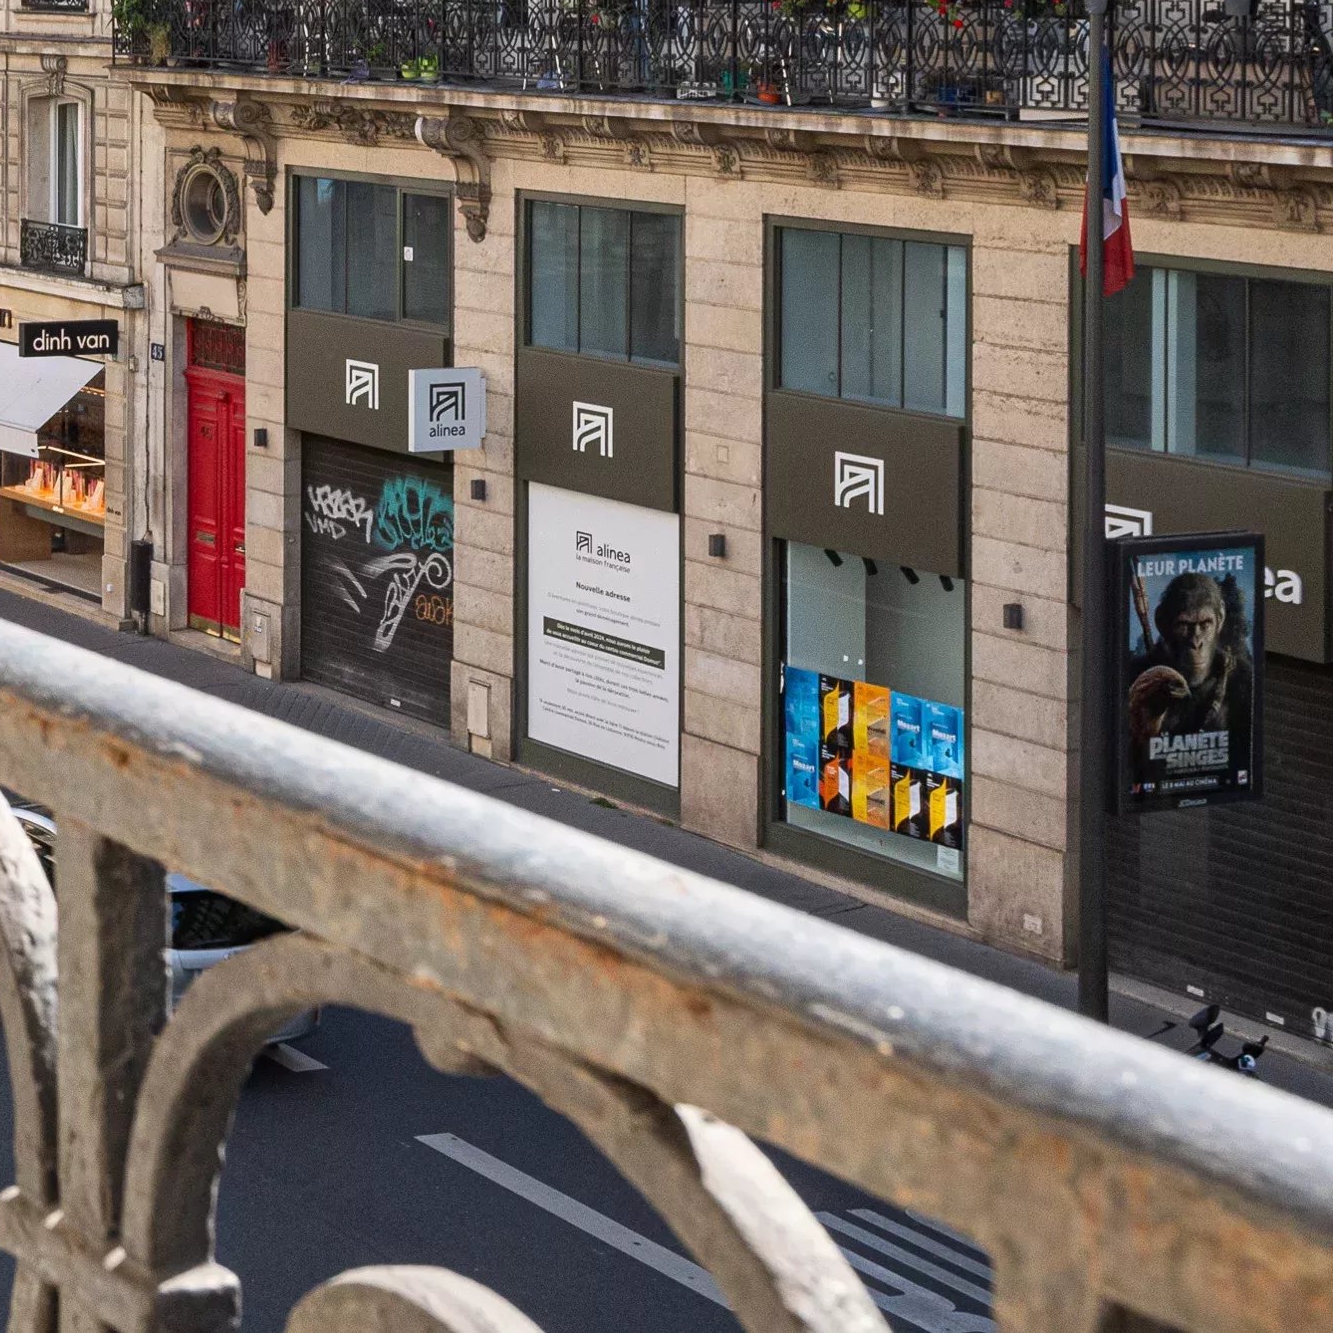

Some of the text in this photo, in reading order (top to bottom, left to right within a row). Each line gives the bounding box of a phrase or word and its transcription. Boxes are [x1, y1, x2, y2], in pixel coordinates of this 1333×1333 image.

[33, 328, 109, 351] dinh van
[152, 346, 163, 359] 45
[429, 424, 466, 438] alinea
[576, 553, 631, 574] la maison française
[597, 543, 631, 564] alinea
[1137, 553, 1244, 577] LEUR PLANÈTE
[576, 581, 604, 596] Nouvelle
[605, 588, 631, 603] adresse
[897, 720, 921, 734] Mozart
[932, 729, 957, 744] Mozart
[1149, 729, 1229, 760] PLANÈTE
[1165, 749, 1229, 769] SINGES
